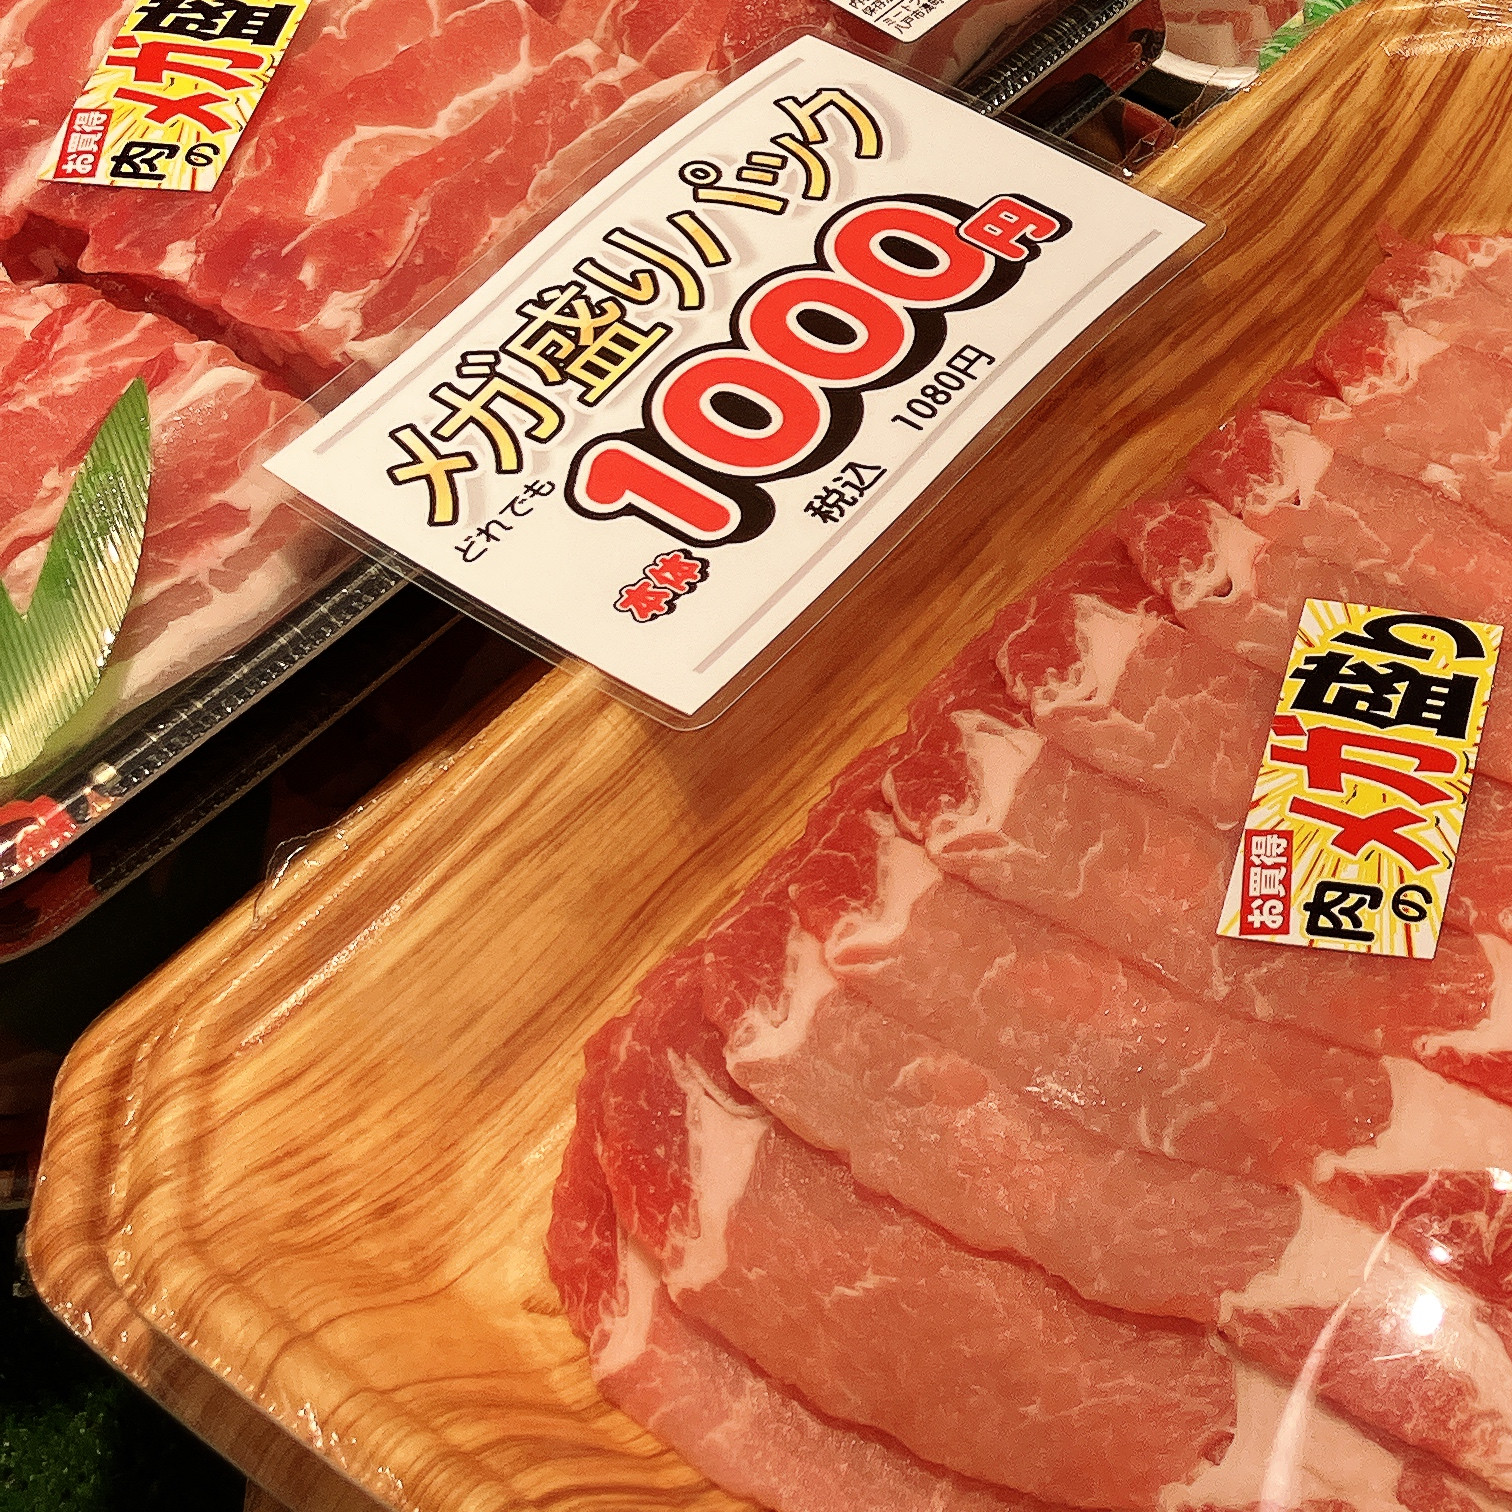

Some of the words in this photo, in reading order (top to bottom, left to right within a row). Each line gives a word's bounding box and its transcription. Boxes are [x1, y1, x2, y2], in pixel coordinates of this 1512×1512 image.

[61, 109, 108, 175] お買得
[387, 87, 885, 530] メガ盛りパック
[565, 193, 1073, 543] 1000円
[805, 462, 889, 528] 税込
[890, 344, 997, 433] 1080円
[454, 477, 556, 564] どれでも
[612, 550, 711, 624] 本体
[1246, 833, 1289, 930] お買得
